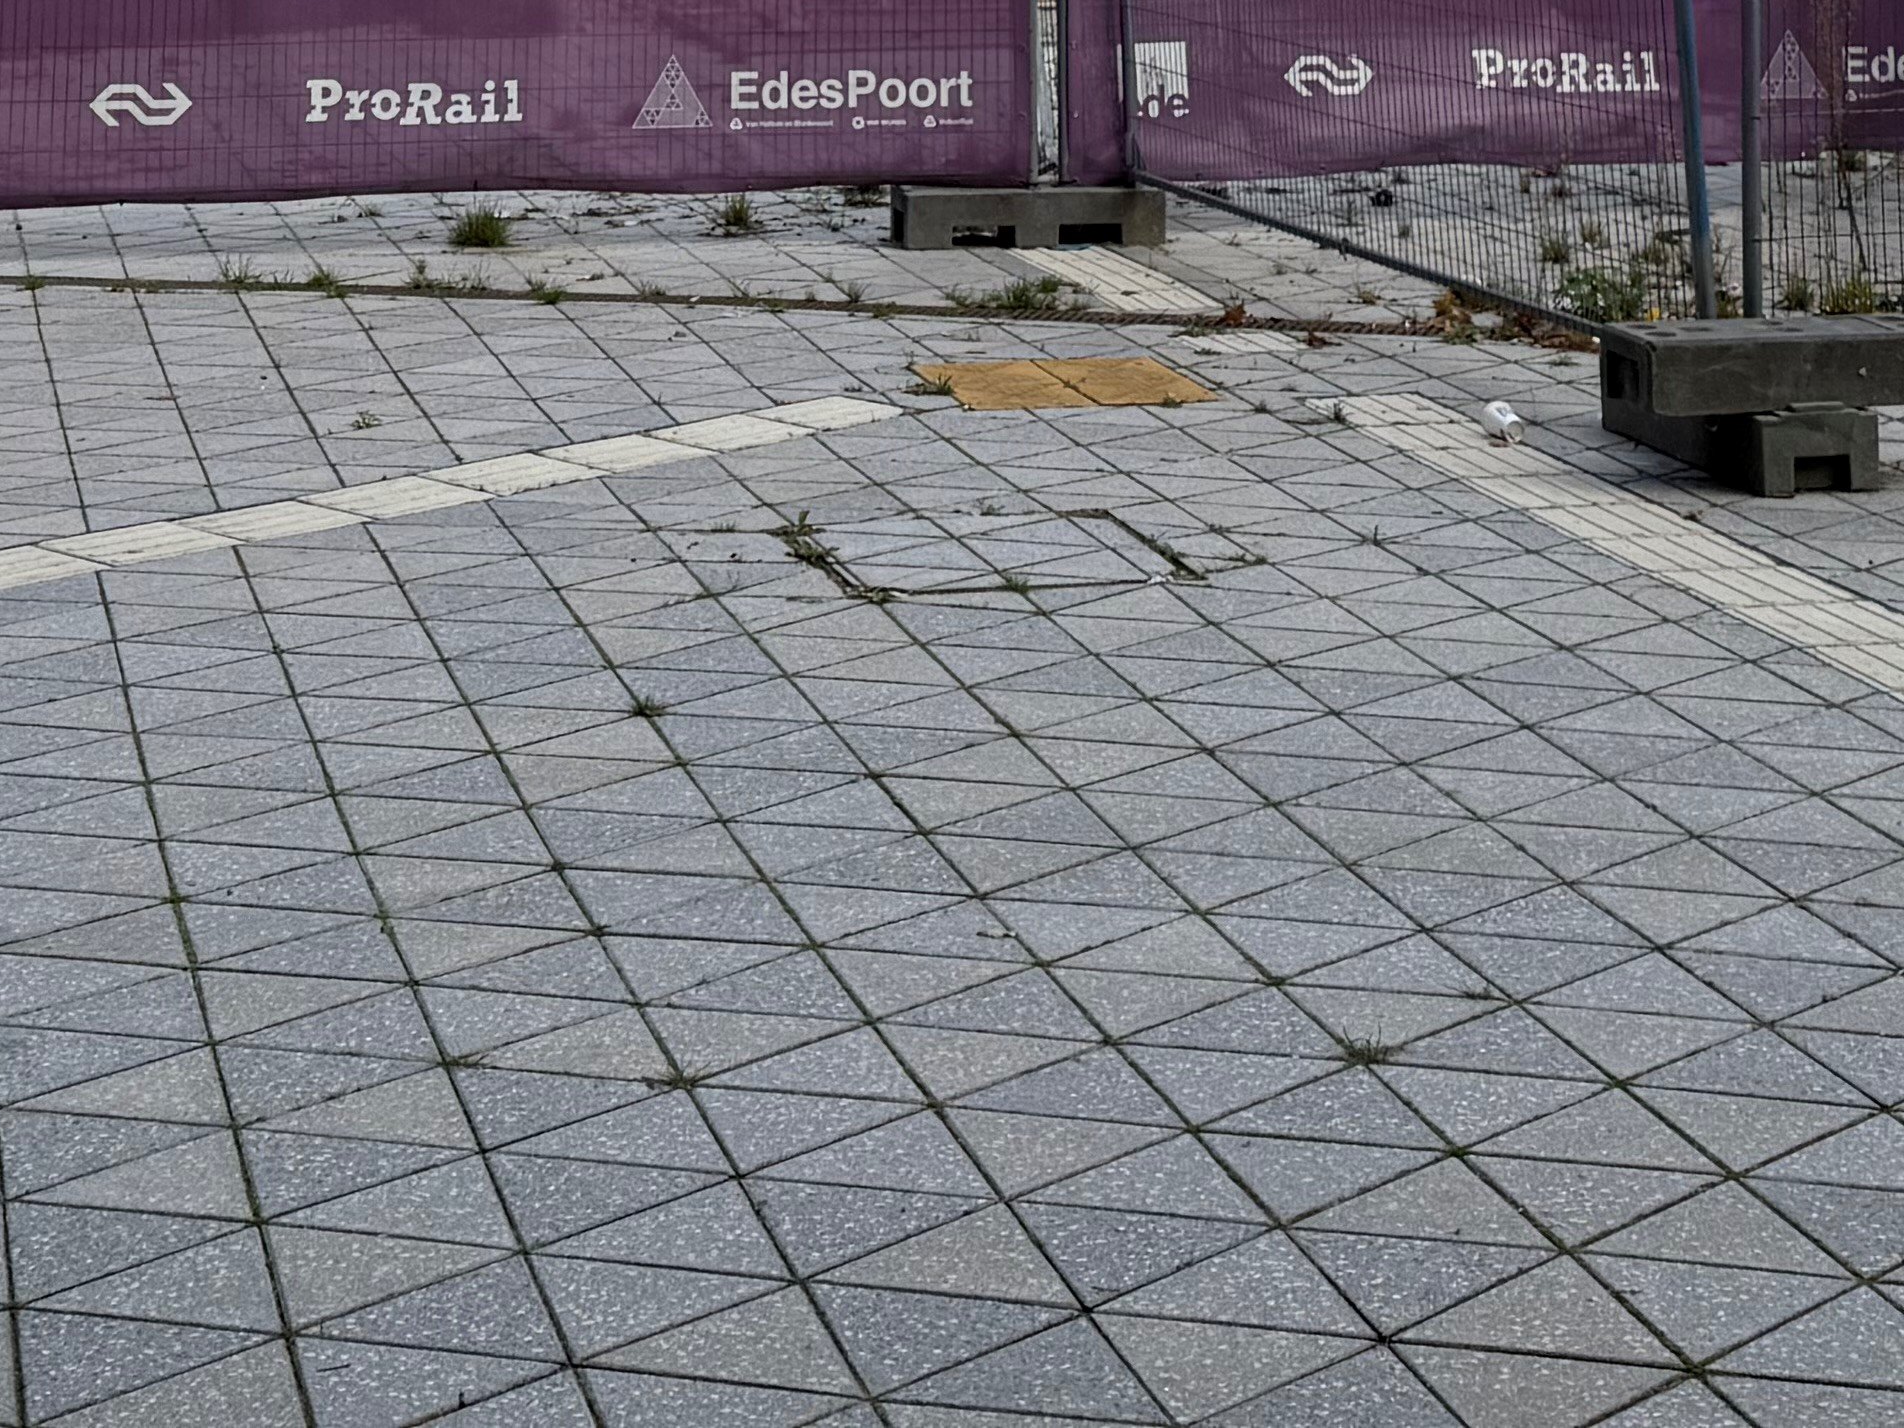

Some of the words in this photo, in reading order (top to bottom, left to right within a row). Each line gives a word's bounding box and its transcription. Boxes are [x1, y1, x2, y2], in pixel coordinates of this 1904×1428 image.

[730, 69, 973, 111] EdesPoort
[1472, 48, 1661, 94] ProRail
[306, 78, 523, 127] ProRail
